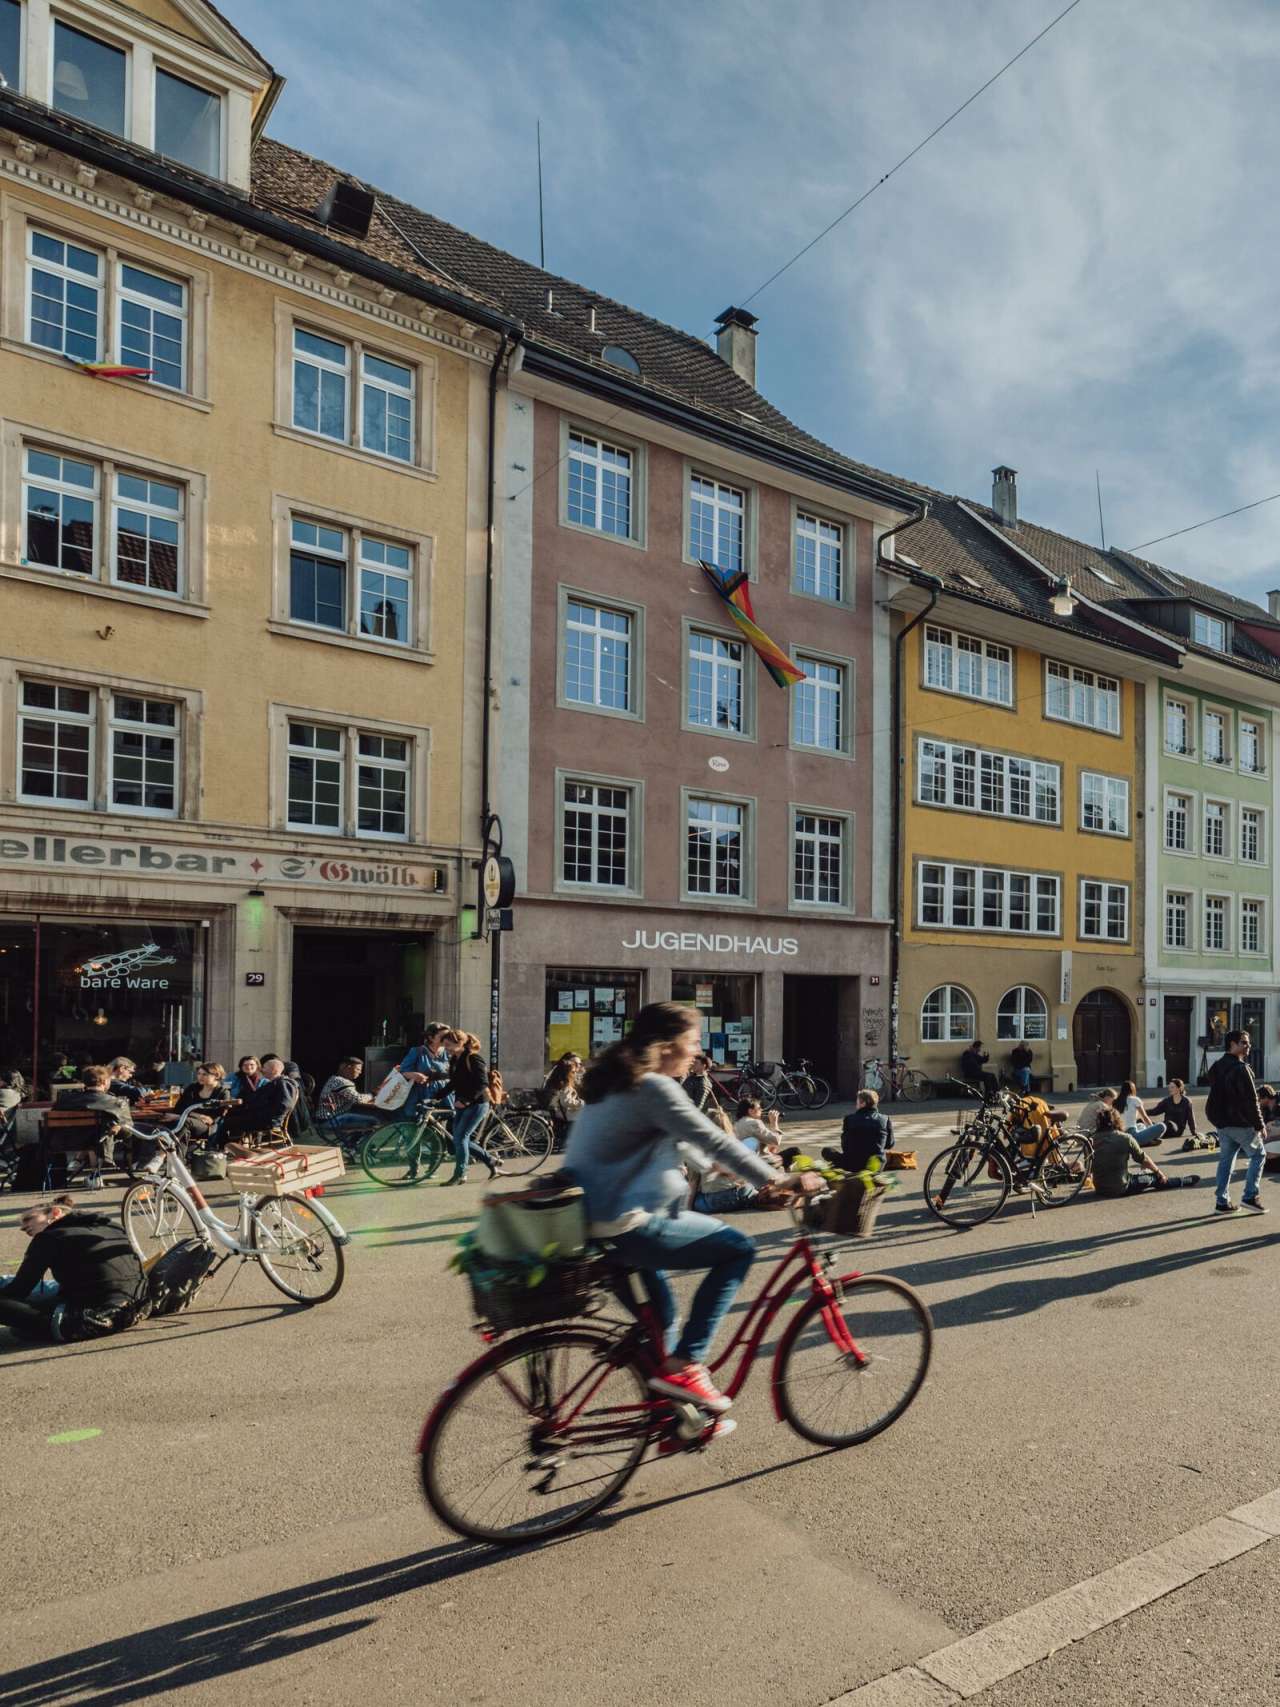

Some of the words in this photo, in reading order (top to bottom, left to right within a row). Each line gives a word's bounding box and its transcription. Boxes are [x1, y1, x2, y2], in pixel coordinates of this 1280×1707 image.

[621, 930, 799, 955] JUGENDHAUS
[80, 975, 121, 989] bare
[247, 974, 263, 983] 29
